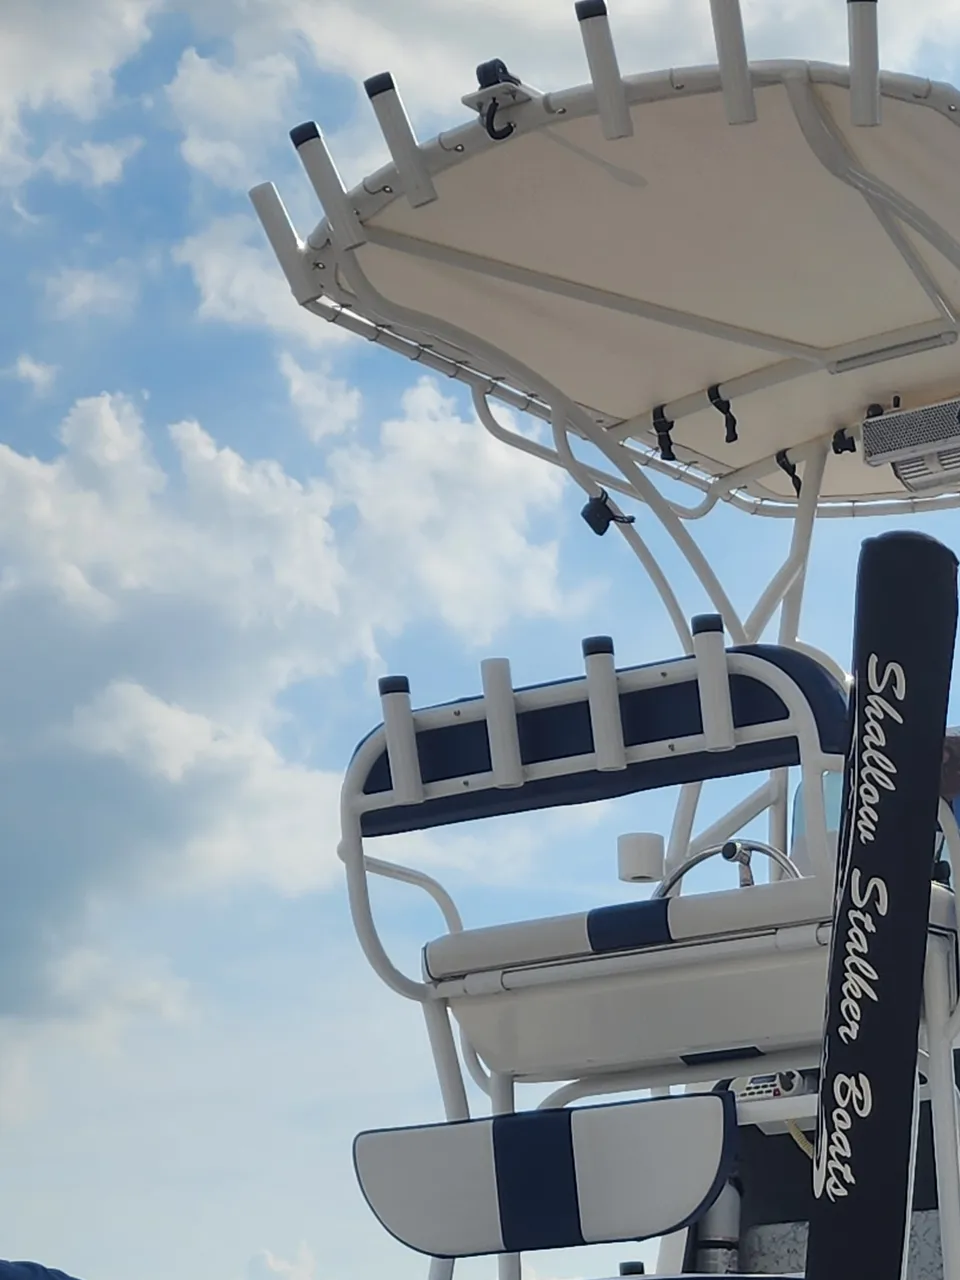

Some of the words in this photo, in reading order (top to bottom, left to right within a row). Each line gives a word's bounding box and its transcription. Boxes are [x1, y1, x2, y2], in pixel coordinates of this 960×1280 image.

[857, 652, 906, 845] Shallow
[838, 867, 889, 1045] Stalker
[825, 1072, 873, 1203] Boats
